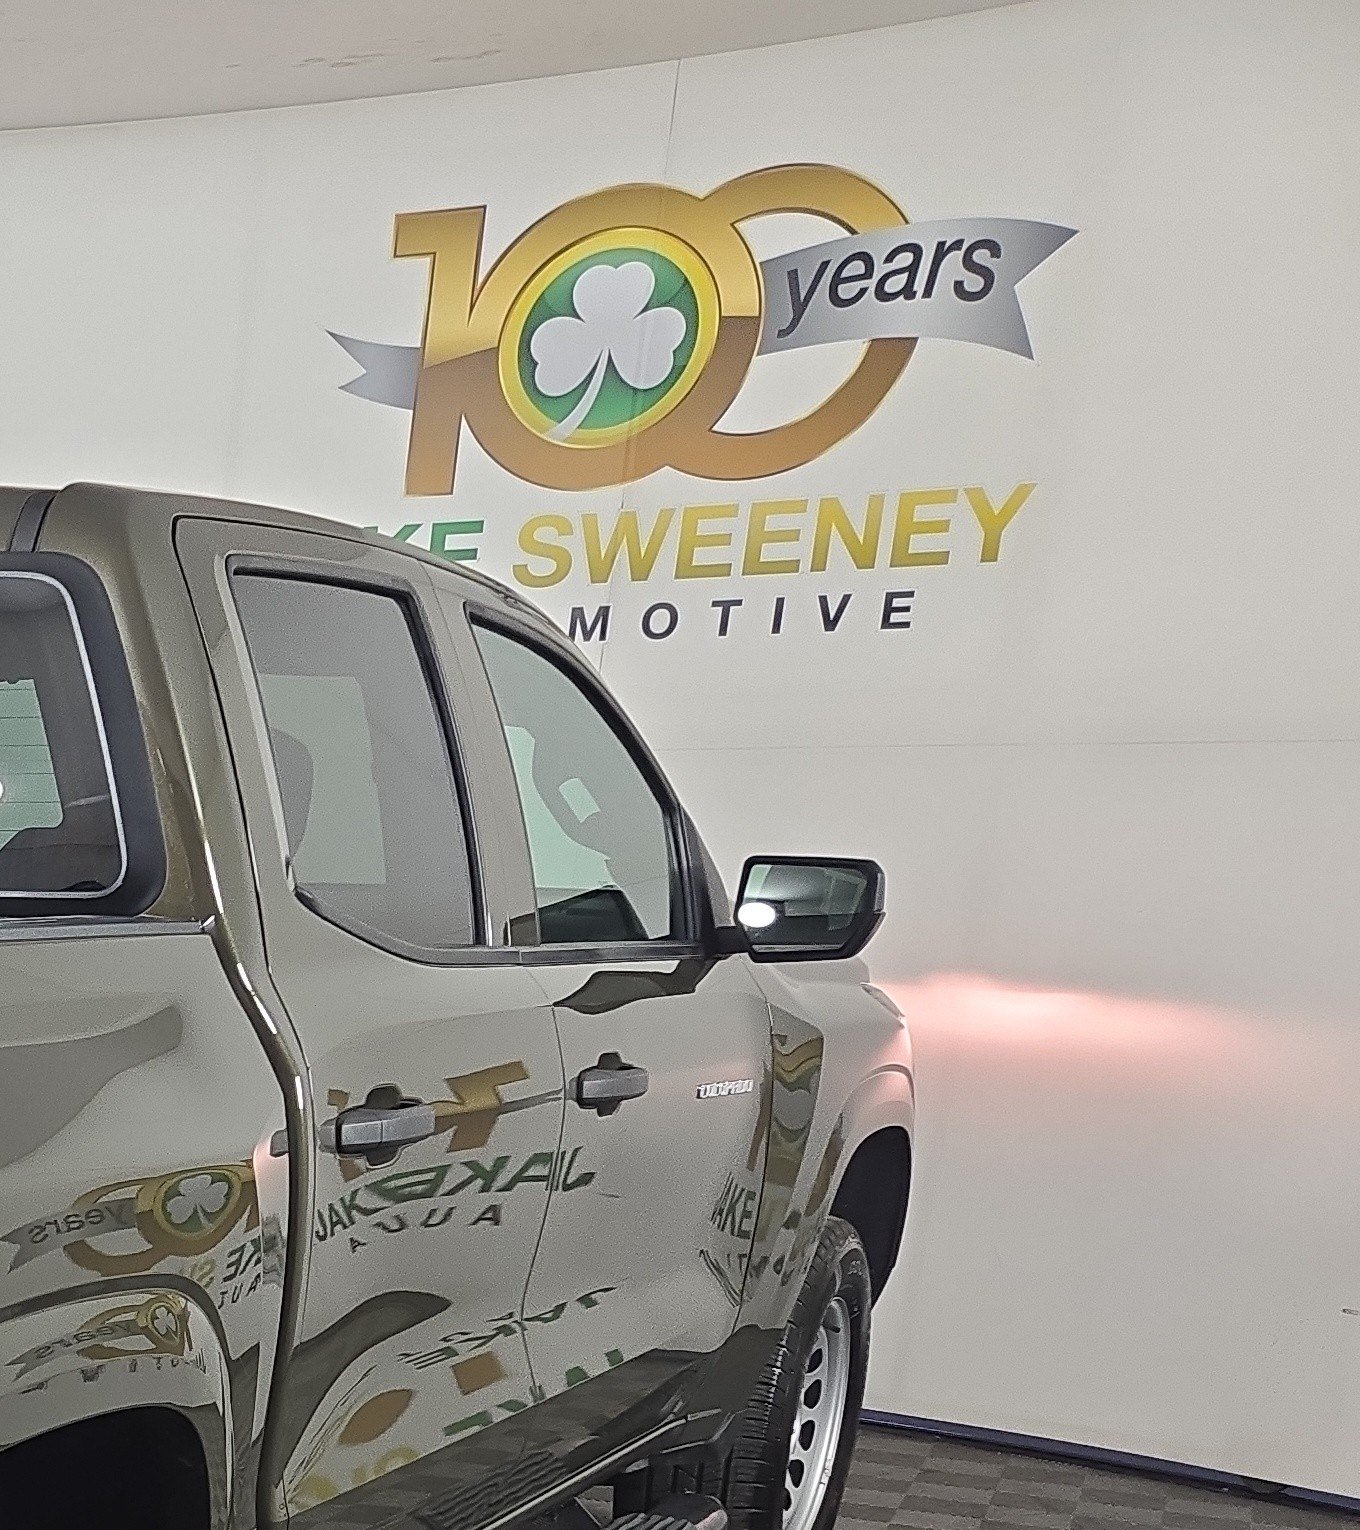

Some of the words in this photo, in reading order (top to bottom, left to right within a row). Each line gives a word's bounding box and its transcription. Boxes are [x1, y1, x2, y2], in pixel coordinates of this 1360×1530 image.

[393, 163, 921, 498] 100
[777, 234, 1002, 338] years
[512, 482, 1038, 589] SWEENEY
